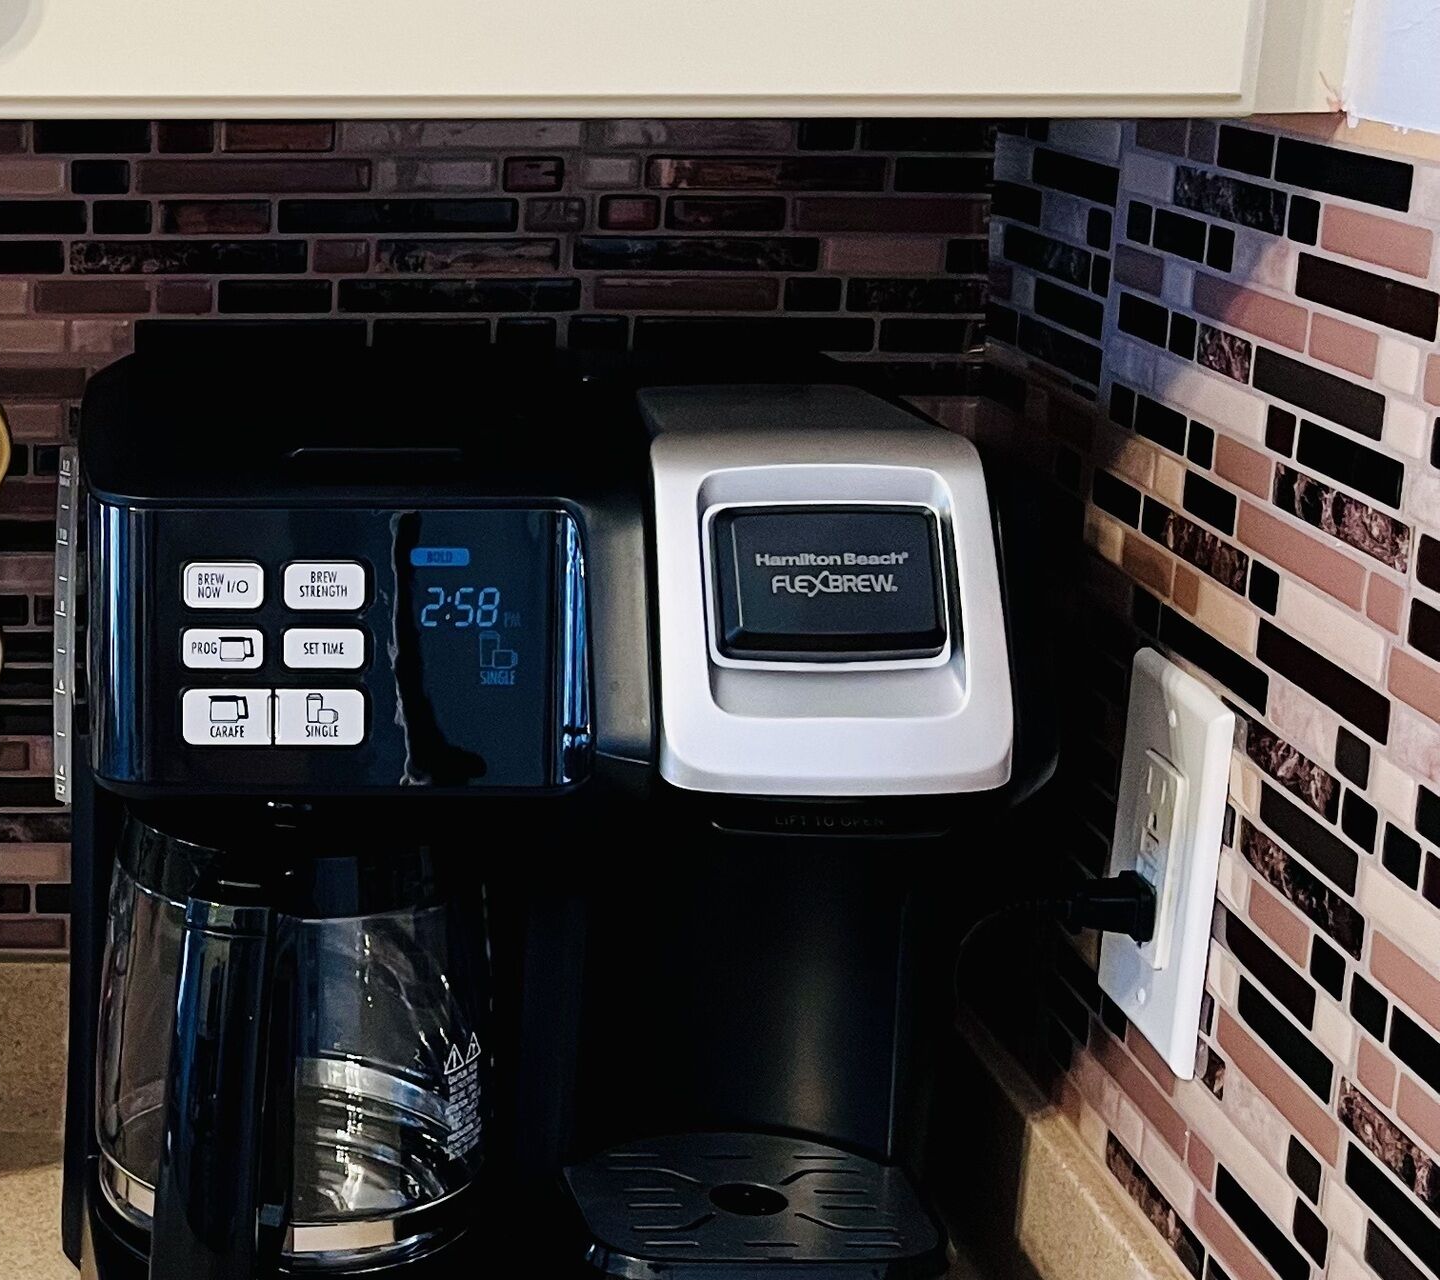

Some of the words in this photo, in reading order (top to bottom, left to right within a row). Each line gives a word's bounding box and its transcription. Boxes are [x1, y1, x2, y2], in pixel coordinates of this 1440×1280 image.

[754, 552, 842, 567] Hamilton
[197, 573, 225, 586] BREW
[310, 571, 338, 583] BREW
[197, 586, 221, 599] NOW
[299, 585, 348, 598] STRENGTH
[421, 587, 500, 627] 2:58
[191, 642, 218, 655] PROG
[303, 642, 320, 655] SET
[322, 642, 345, 655] TIME
[480, 670, 516, 685] SINGLE
[209, 725, 245, 738] CARAFE
[305, 725, 339, 738] SINGLE
